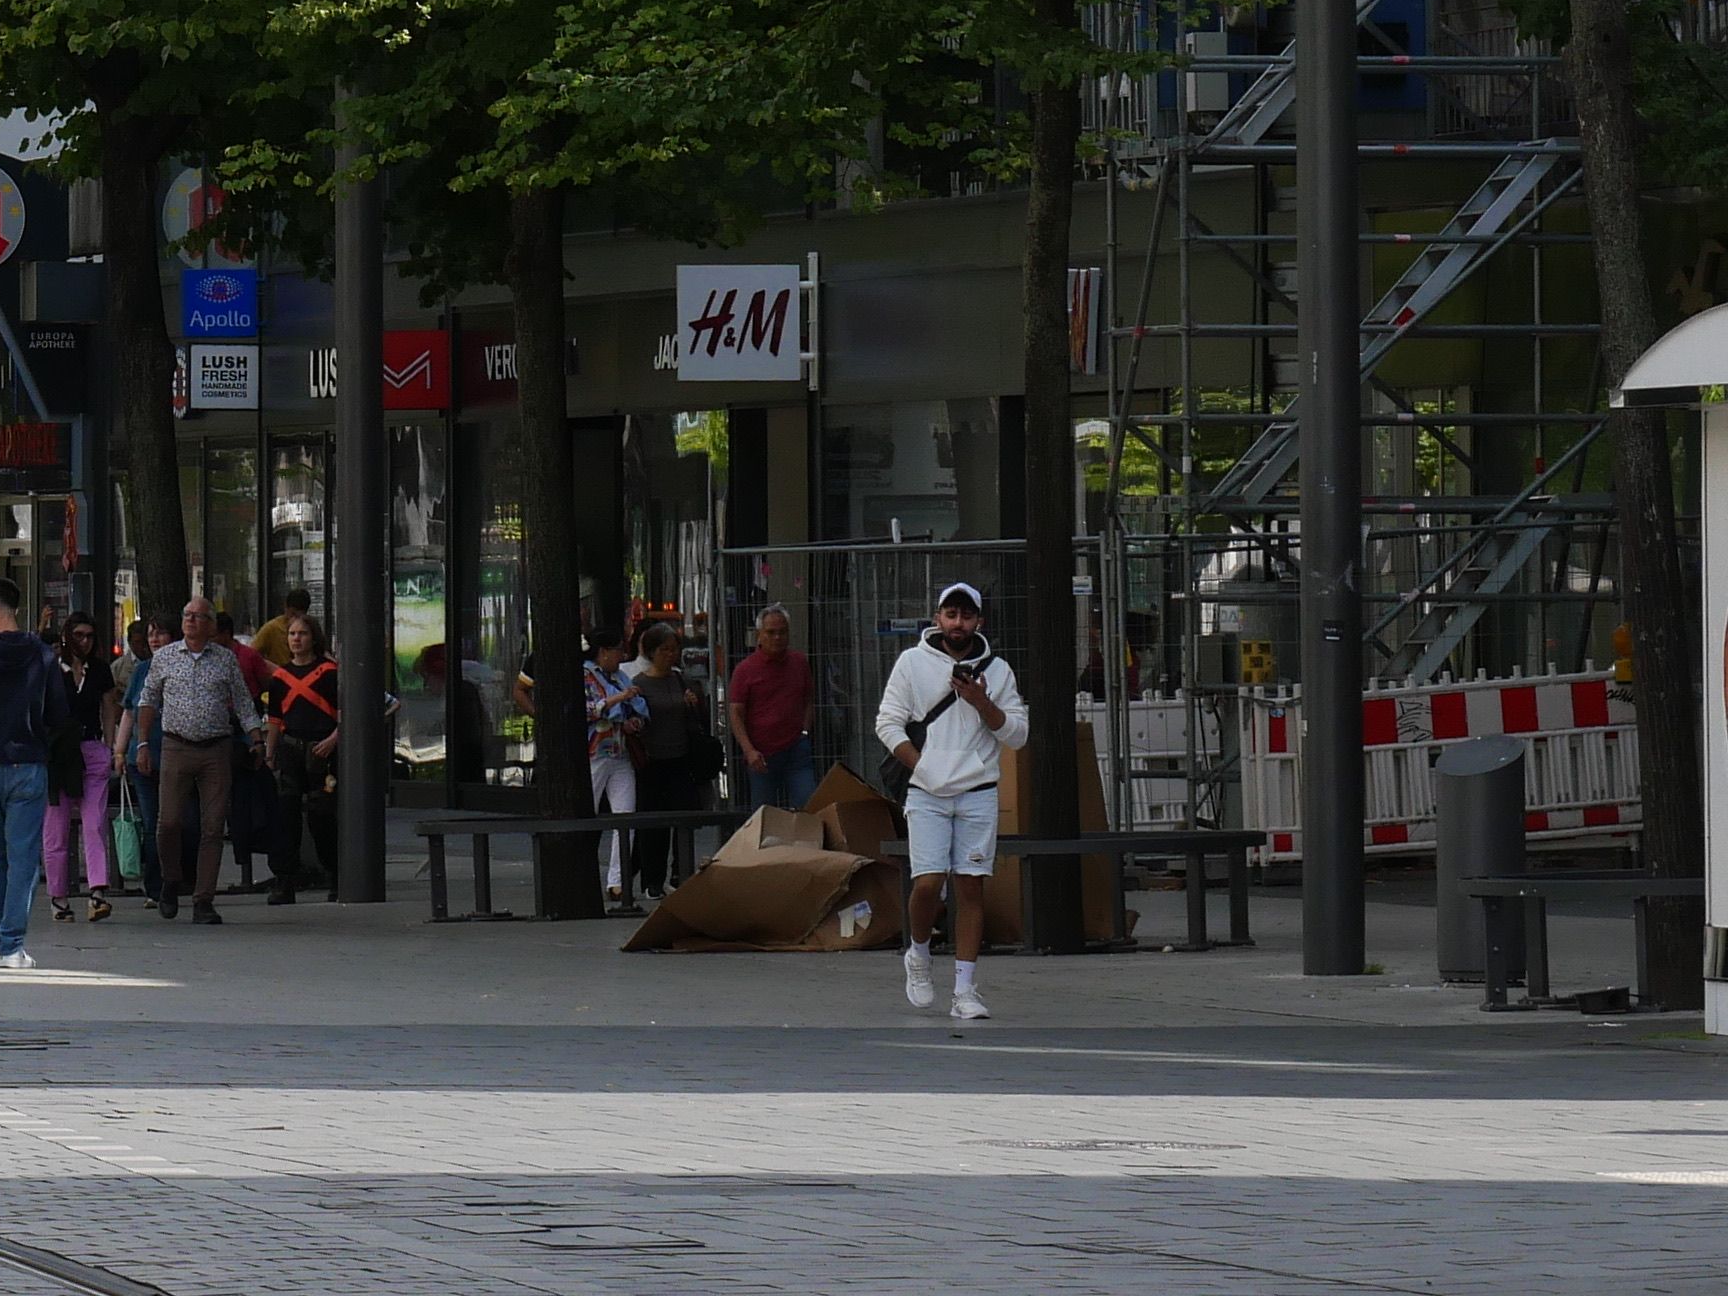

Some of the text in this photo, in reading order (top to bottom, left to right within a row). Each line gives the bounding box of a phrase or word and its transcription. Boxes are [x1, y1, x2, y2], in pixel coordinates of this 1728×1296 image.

[189, 310, 251, 332] Apollo
[688, 288, 790, 358] H&M
[30, 331, 74, 340] EUROPA
[28, 340, 76, 349] APOTHEKE
[201, 356, 248, 369] LUSH
[201, 370, 248, 382] FRESH
